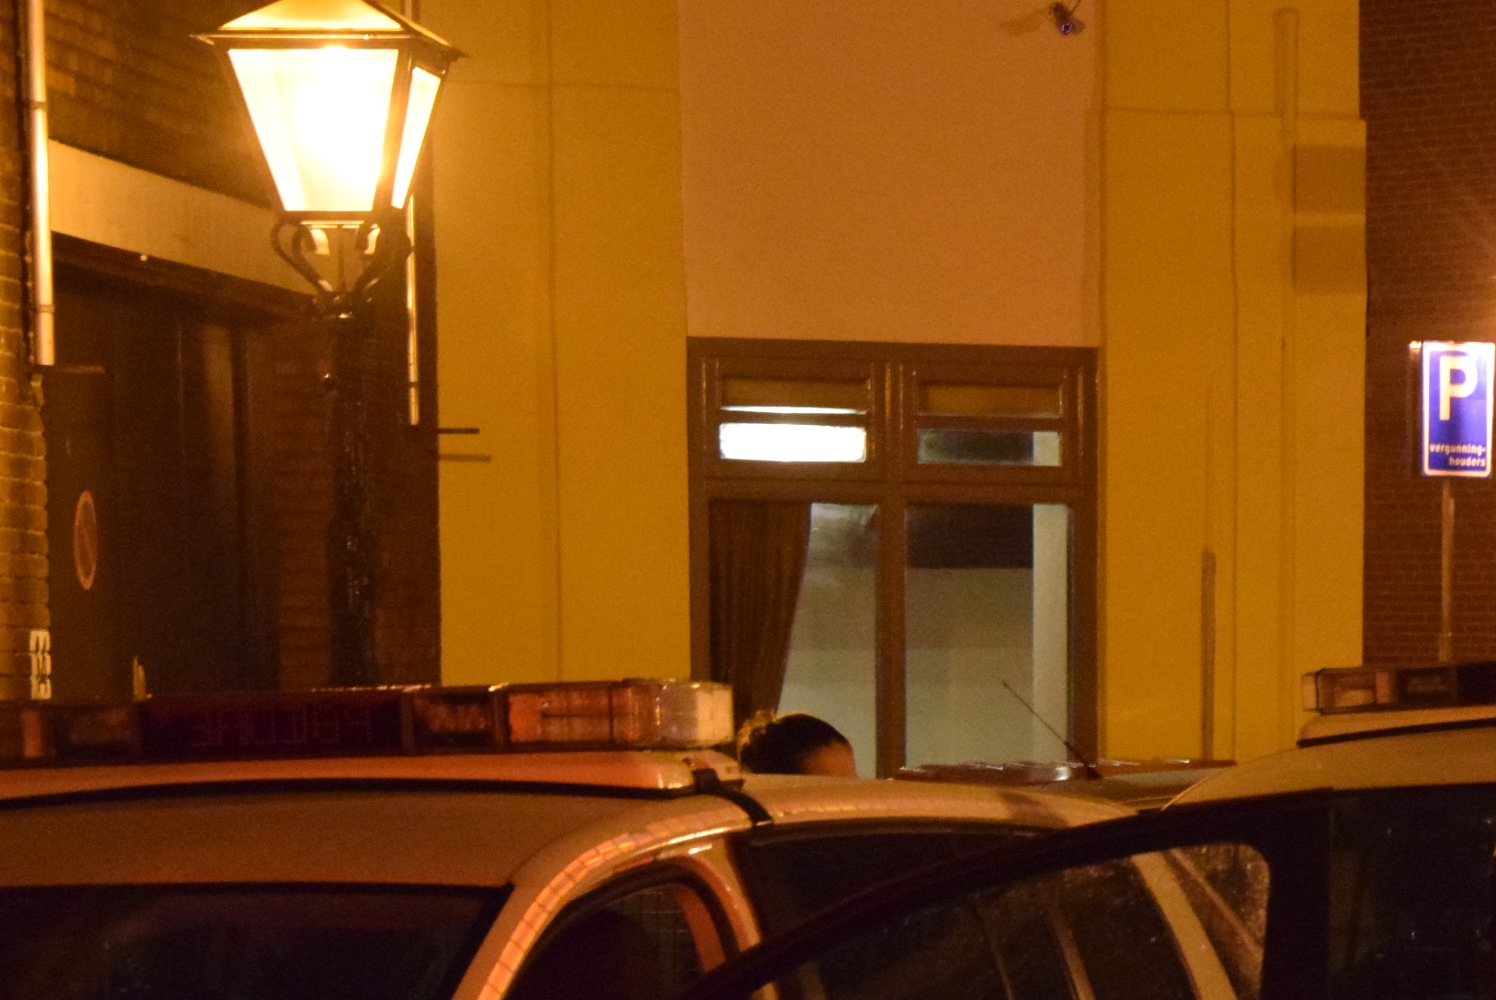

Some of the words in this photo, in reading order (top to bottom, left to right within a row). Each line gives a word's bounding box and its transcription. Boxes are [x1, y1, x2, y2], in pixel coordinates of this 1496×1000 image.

[1439, 354, 1478, 421] P
[1429, 443, 1486, 456] vergunning-
[1448, 456, 1486, 467] houders
